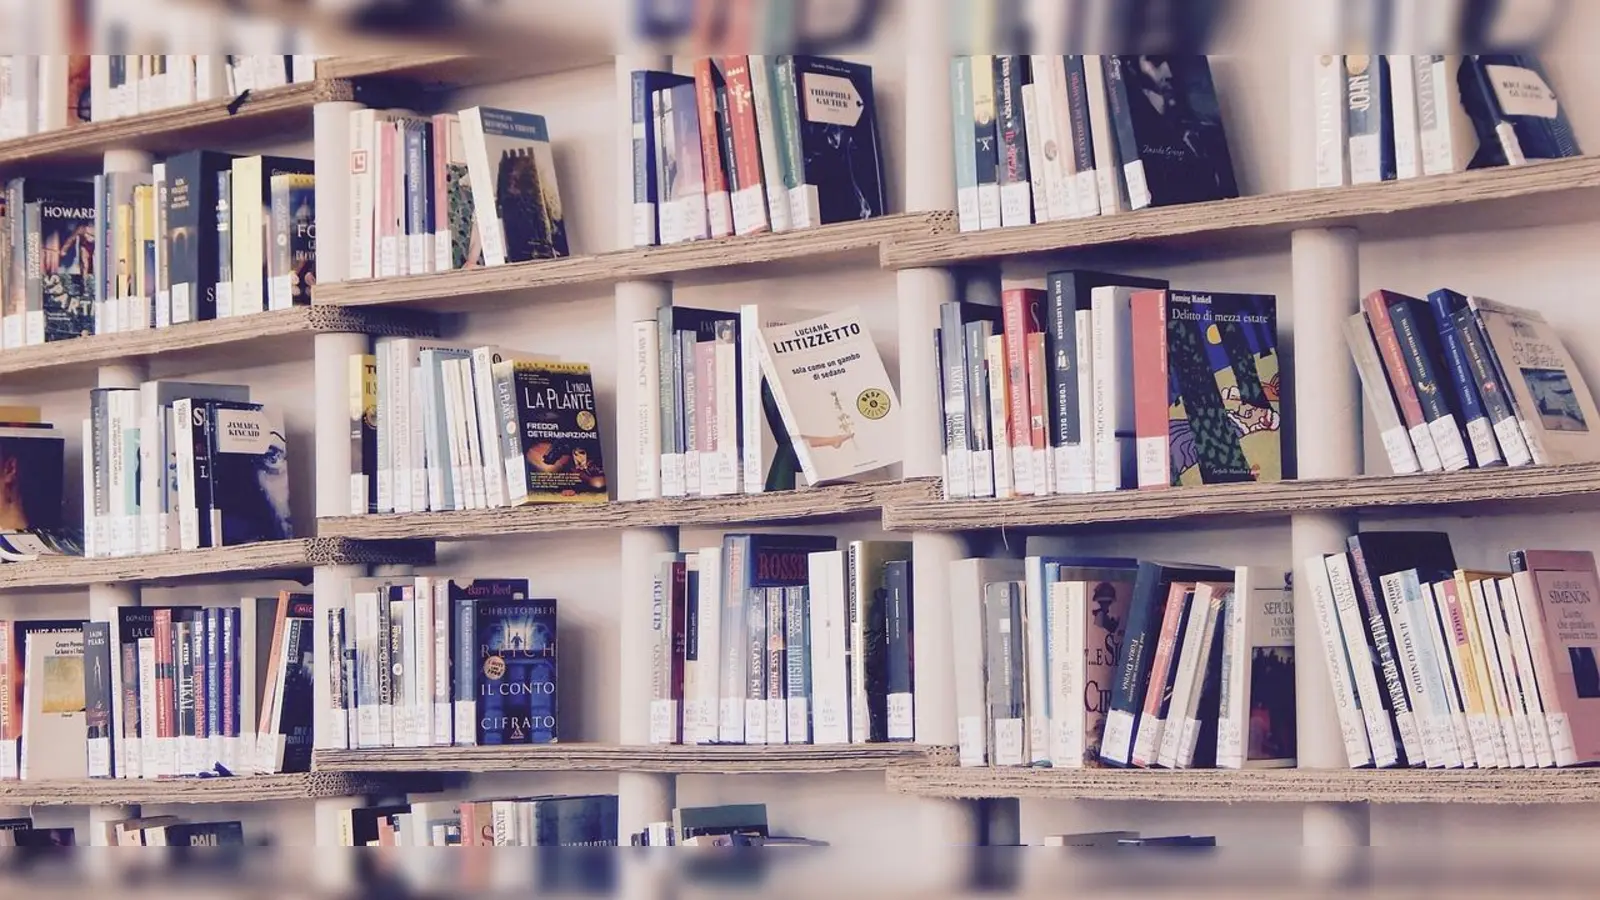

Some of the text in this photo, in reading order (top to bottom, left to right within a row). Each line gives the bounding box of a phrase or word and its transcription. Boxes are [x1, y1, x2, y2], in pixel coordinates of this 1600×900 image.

[1348, 75, 1370, 111] JOHN
[1418, 55, 1434, 126] RISHAM
[44, 206, 95, 219] HOWARD
[1171, 307, 1269, 323] Delitto di mezza estate
[794, 322, 830, 337] LUCIANA
[772, 322, 861, 354] LITTIZZETTO
[792, 351, 861, 375] sola come un gambo
[812, 367, 846, 381] di sedano
[547, 389, 593, 410] PLANTE
[1059, 383, 1068, 439] L'ORDINE DELLA
[227, 421, 260, 431] JAMAICA
[228, 430, 260, 438] KINCAID
[527, 430, 597, 440] DETERMINAZIONE
[1548, 591, 1591, 604] SIMENON
[480, 606, 555, 615] CHRISTOPHER
[481, 643, 556, 657] REICH
[1368, 613, 1391, 651] NULLA
[1380, 659, 1400, 684] PER
[751, 641, 762, 700] CLASSE KIL
[1121, 638, 1137, 691] FURIA DIVINA
[1401, 631, 1417, 663] VOLTO
[1409, 663, 1425, 695] NUDO
[481, 682, 555, 695] IL CONTO
[1, 685, 9, 727] GIULLARE
[480, 715, 555, 730] CIFRATO
